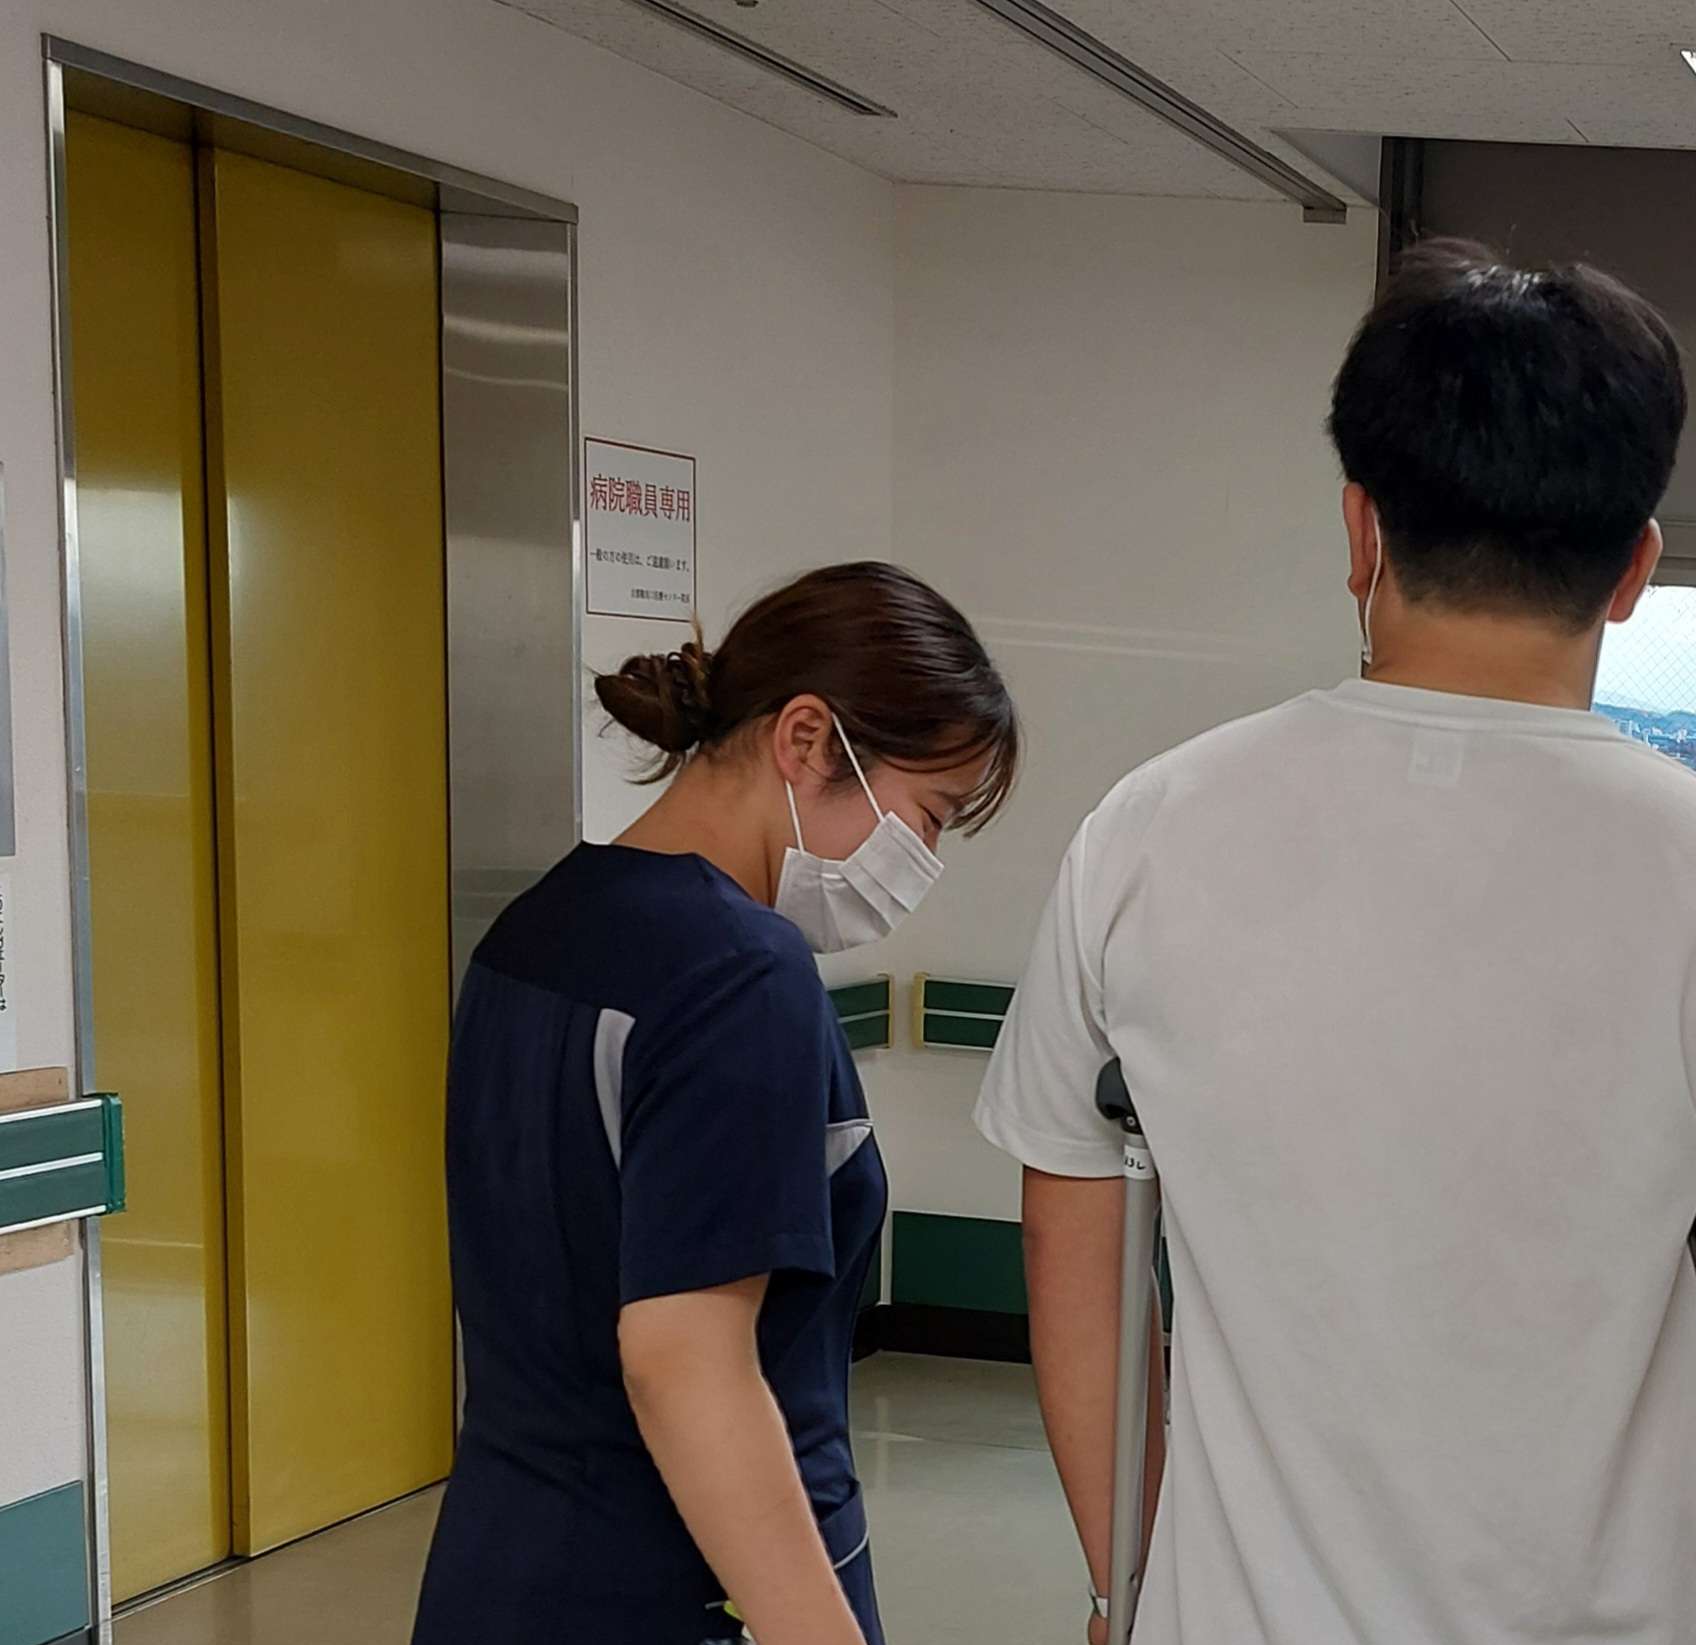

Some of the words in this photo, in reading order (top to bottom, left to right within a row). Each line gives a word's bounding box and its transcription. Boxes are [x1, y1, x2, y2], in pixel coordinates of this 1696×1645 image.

[590, 473, 691, 523] 病院職員専用
